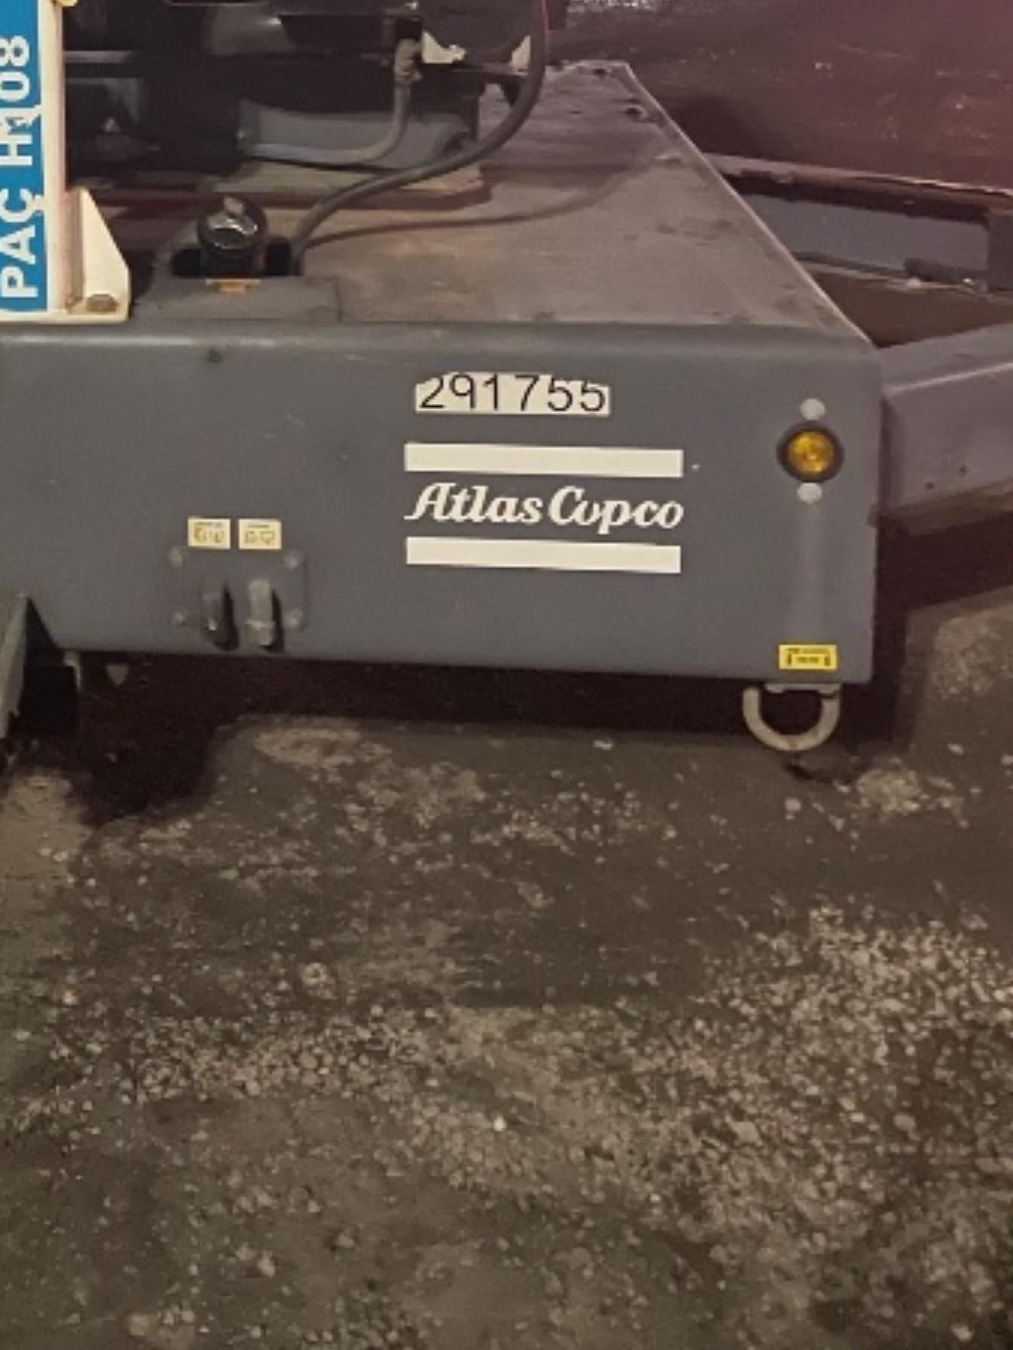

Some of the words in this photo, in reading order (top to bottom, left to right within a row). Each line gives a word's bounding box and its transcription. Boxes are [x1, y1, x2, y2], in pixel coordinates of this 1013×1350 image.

[420, 374, 607, 410] 291755
[404, 483, 543, 524] Atlas
[548, 486, 683, 534] Copco
